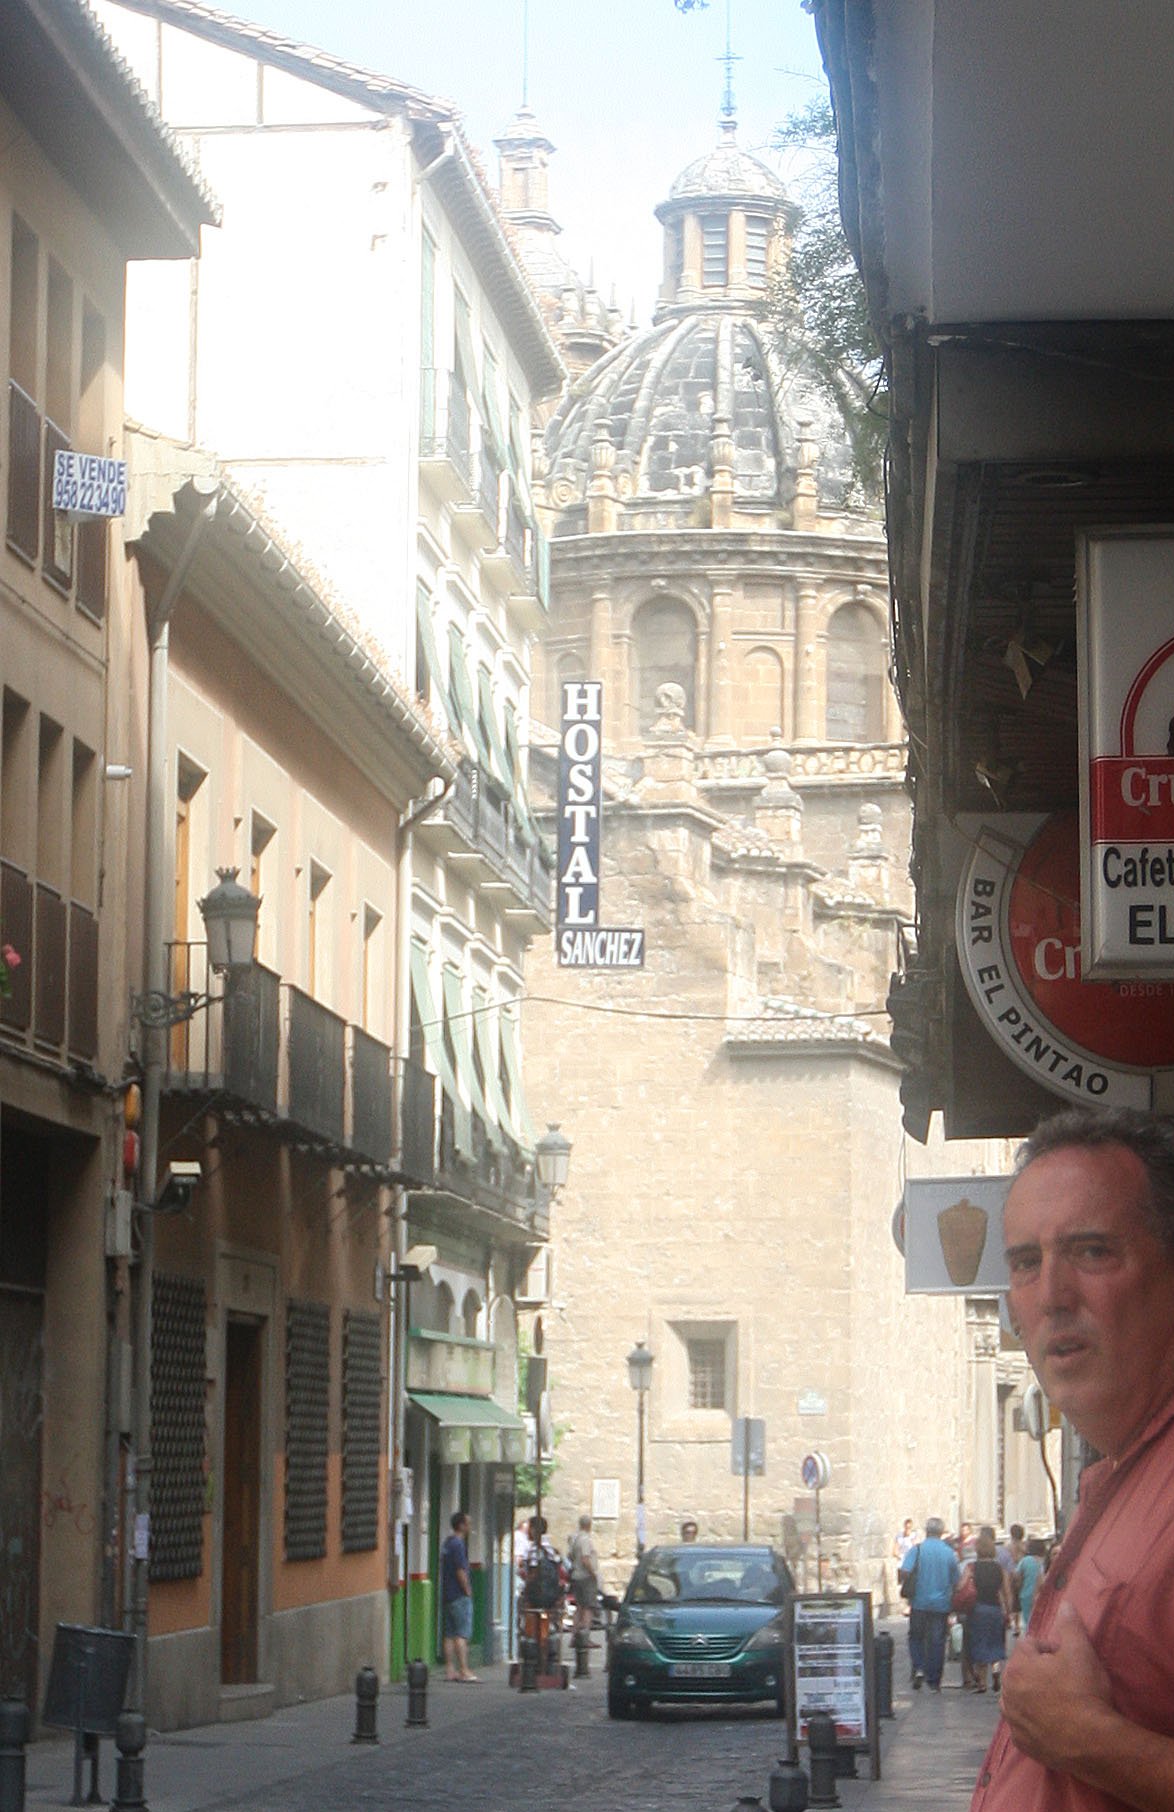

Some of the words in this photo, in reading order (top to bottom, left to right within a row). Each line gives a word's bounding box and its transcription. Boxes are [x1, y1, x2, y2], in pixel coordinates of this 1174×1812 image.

[57, 454, 74, 477] SE
[79, 456, 126, 485] VENDE
[562, 684, 601, 925] HOSTAL
[971, 877, 996, 946] BAR
[561, 930, 643, 966] SANCHEZ
[977, 964, 1005, 1004] EL
[998, 1006, 1109, 1095] PINTAO
